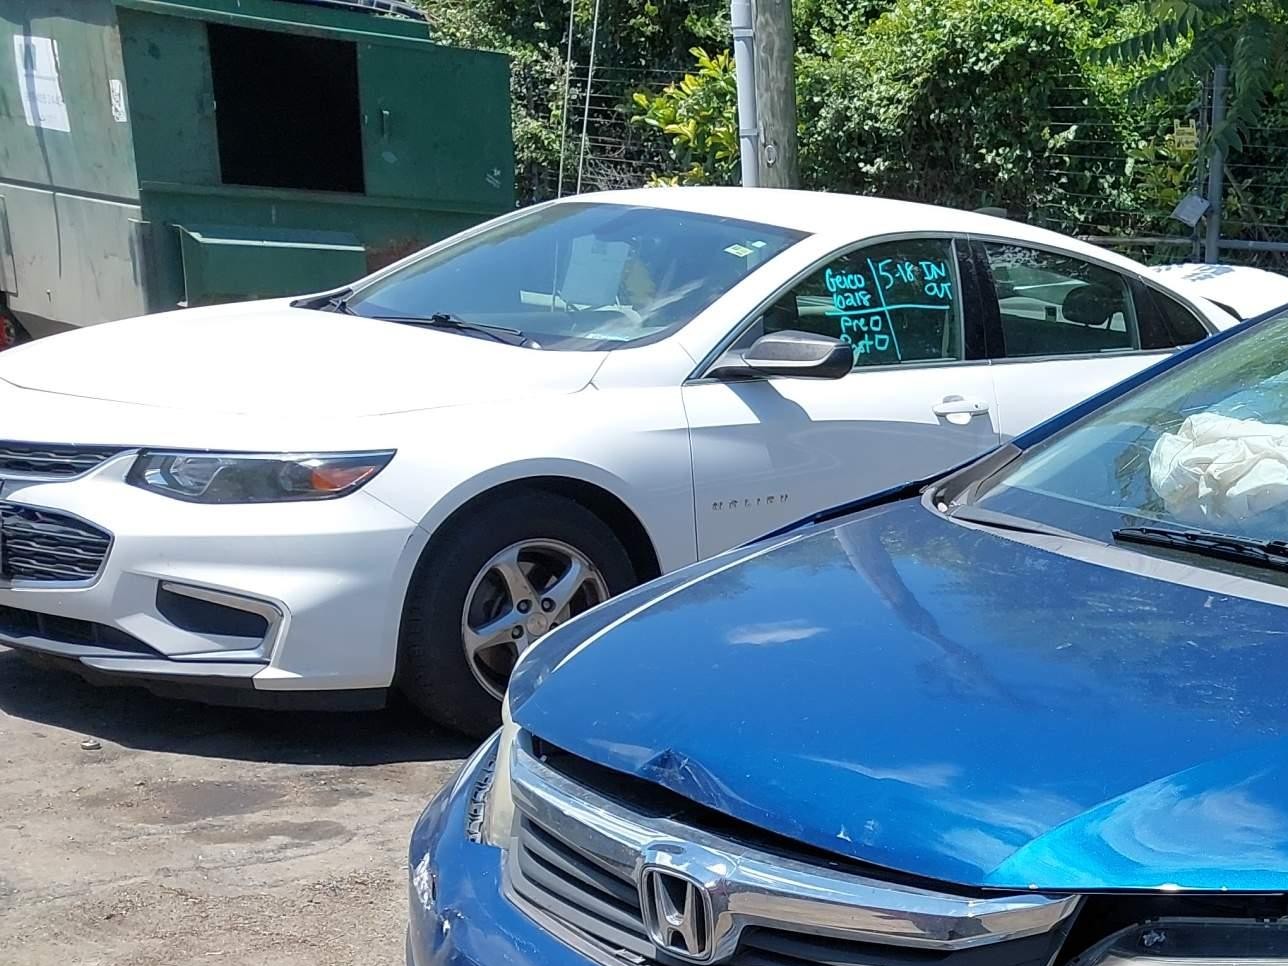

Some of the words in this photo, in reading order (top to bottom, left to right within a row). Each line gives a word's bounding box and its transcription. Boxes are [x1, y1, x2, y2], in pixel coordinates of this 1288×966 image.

[825, 268, 865, 292] Geico
[878, 258, 915, 289] 5-18
[919, 261, 946, 280] IN
[924, 282, 953, 300] OUT
